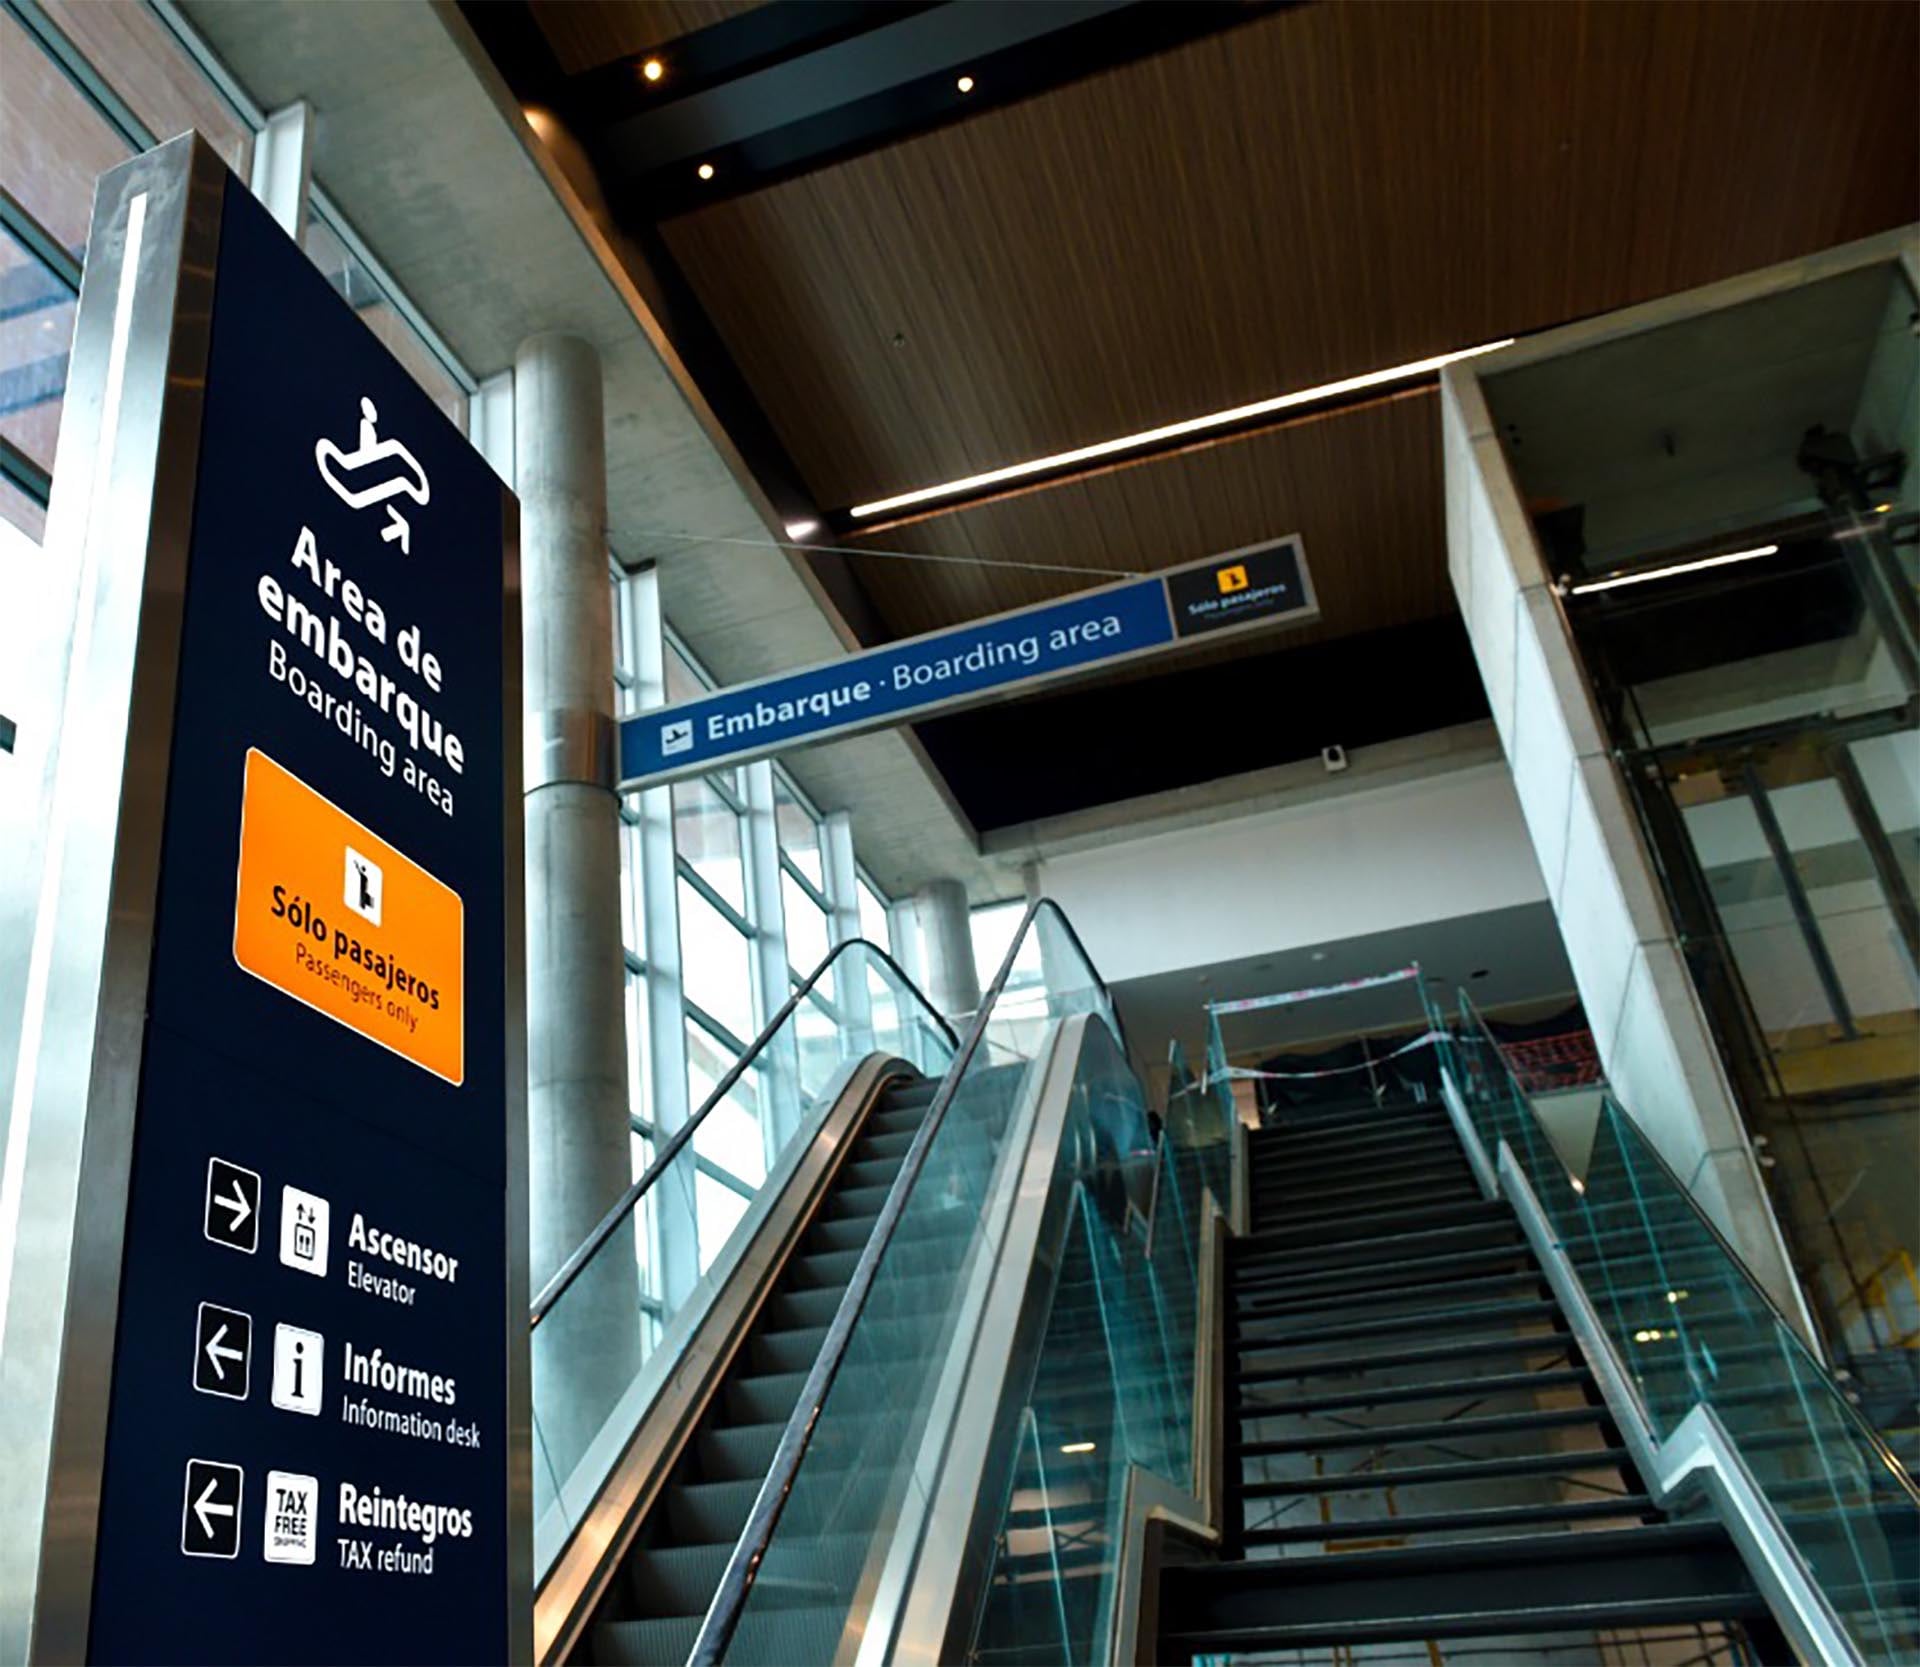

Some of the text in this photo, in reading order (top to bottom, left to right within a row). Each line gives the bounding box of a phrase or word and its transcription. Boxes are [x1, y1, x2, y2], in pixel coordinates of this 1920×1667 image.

[291, 525, 442, 692] Area de
[257, 574, 465, 775] embarque
[706, 612, 1122, 741] Embarque Boarding area
[268, 639, 455, 818] Boarding area
[270, 885, 440, 1011] Sólo pasajeros
[295, 942, 420, 1034] Passengers only
[348, 1213, 459, 1284] Ascensor
[347, 1260, 416, 1307] Elevator
[343, 1342, 457, 1406] Informes
[341, 1395, 481, 1449] Information desk
[273, 1514, 309, 1537] FREE
[275, 1488, 309, 1516] TAX
[338, 1482, 474, 1545] Reintegros
[337, 1537, 374, 1572] TAX
[376, 1543, 434, 1575] refund
